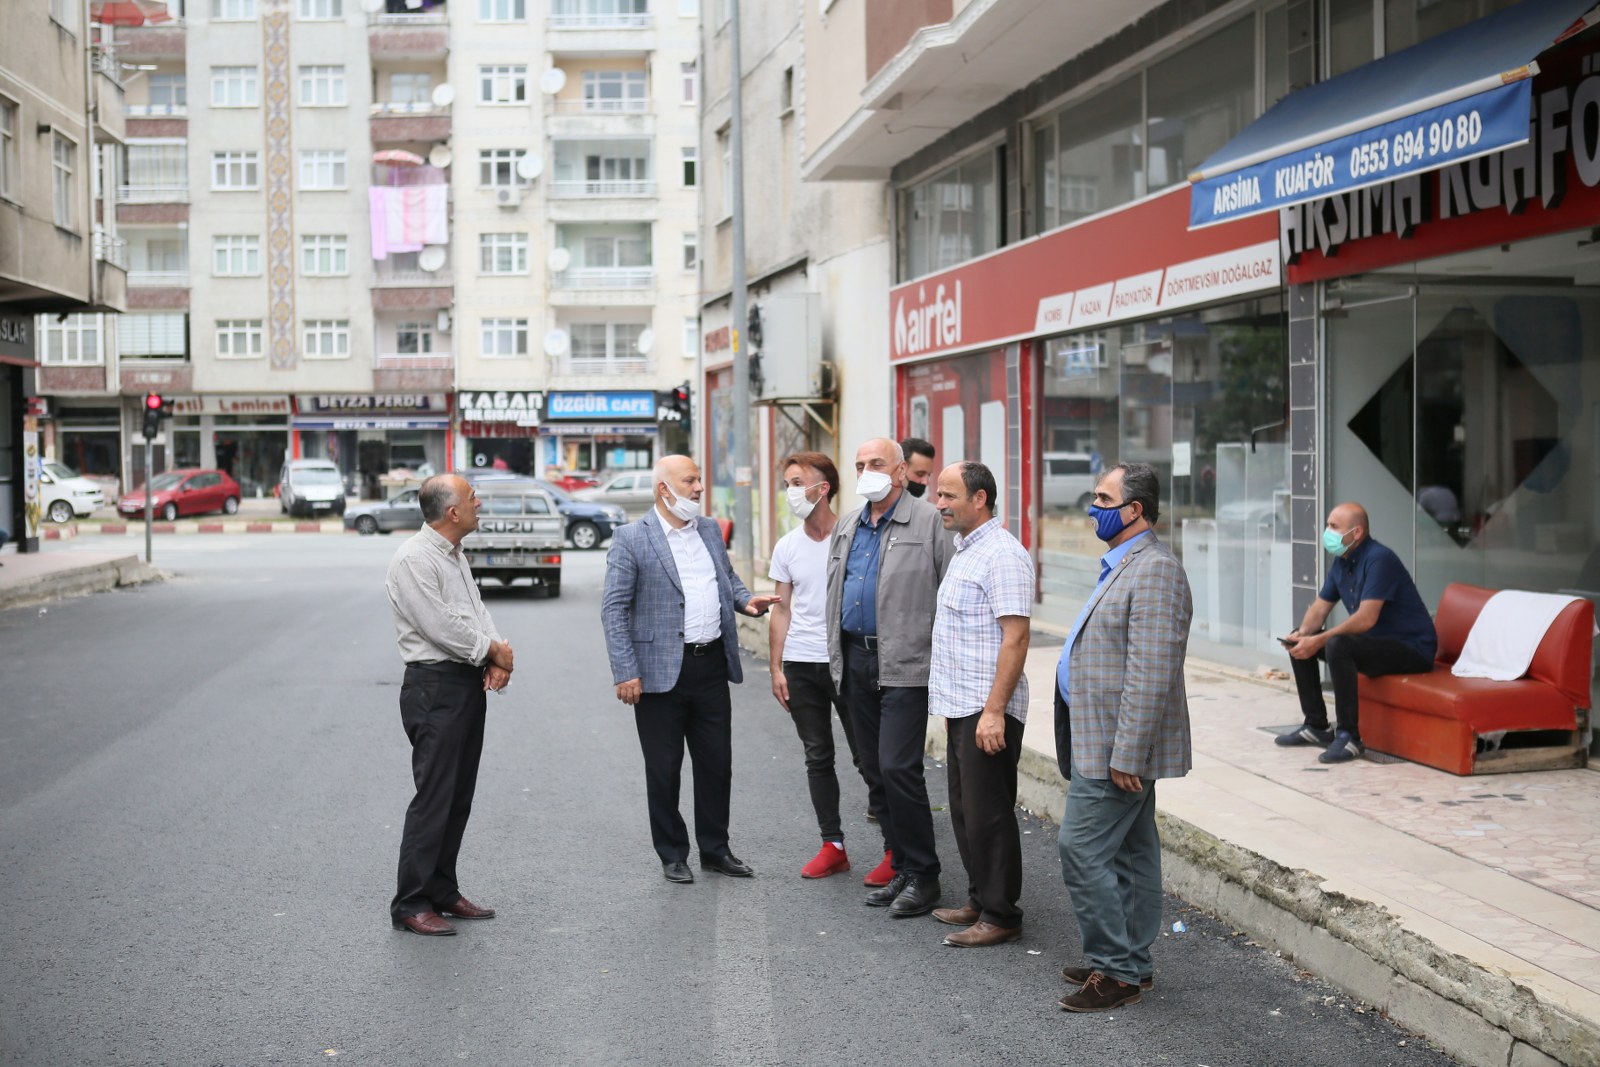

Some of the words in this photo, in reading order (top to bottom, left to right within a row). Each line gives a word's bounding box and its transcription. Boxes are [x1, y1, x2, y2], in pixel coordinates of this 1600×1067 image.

[1213, 175, 1261, 215] ARSİMA
[1275, 152, 1334, 198] KUAFÖR
[1350, 139, 1389, 178] 0553
[1393, 127, 1424, 167] 694
[1429, 119, 1453, 156] 90
[1456, 110, 1482, 149] 80
[907, 279, 962, 354] airfel
[1080, 300, 1102, 317] KAZAN
[1115, 287, 1153, 309] RADYATÖR
[1167, 269, 1220, 297] DÖRTMEVSİM
[1222, 258, 1273, 285] DOĞALGAZ
[0, 318, 28, 344] SLAR
[552, 394, 609, 413] ÖZGÜR
[611, 399, 650, 412] CAFE
